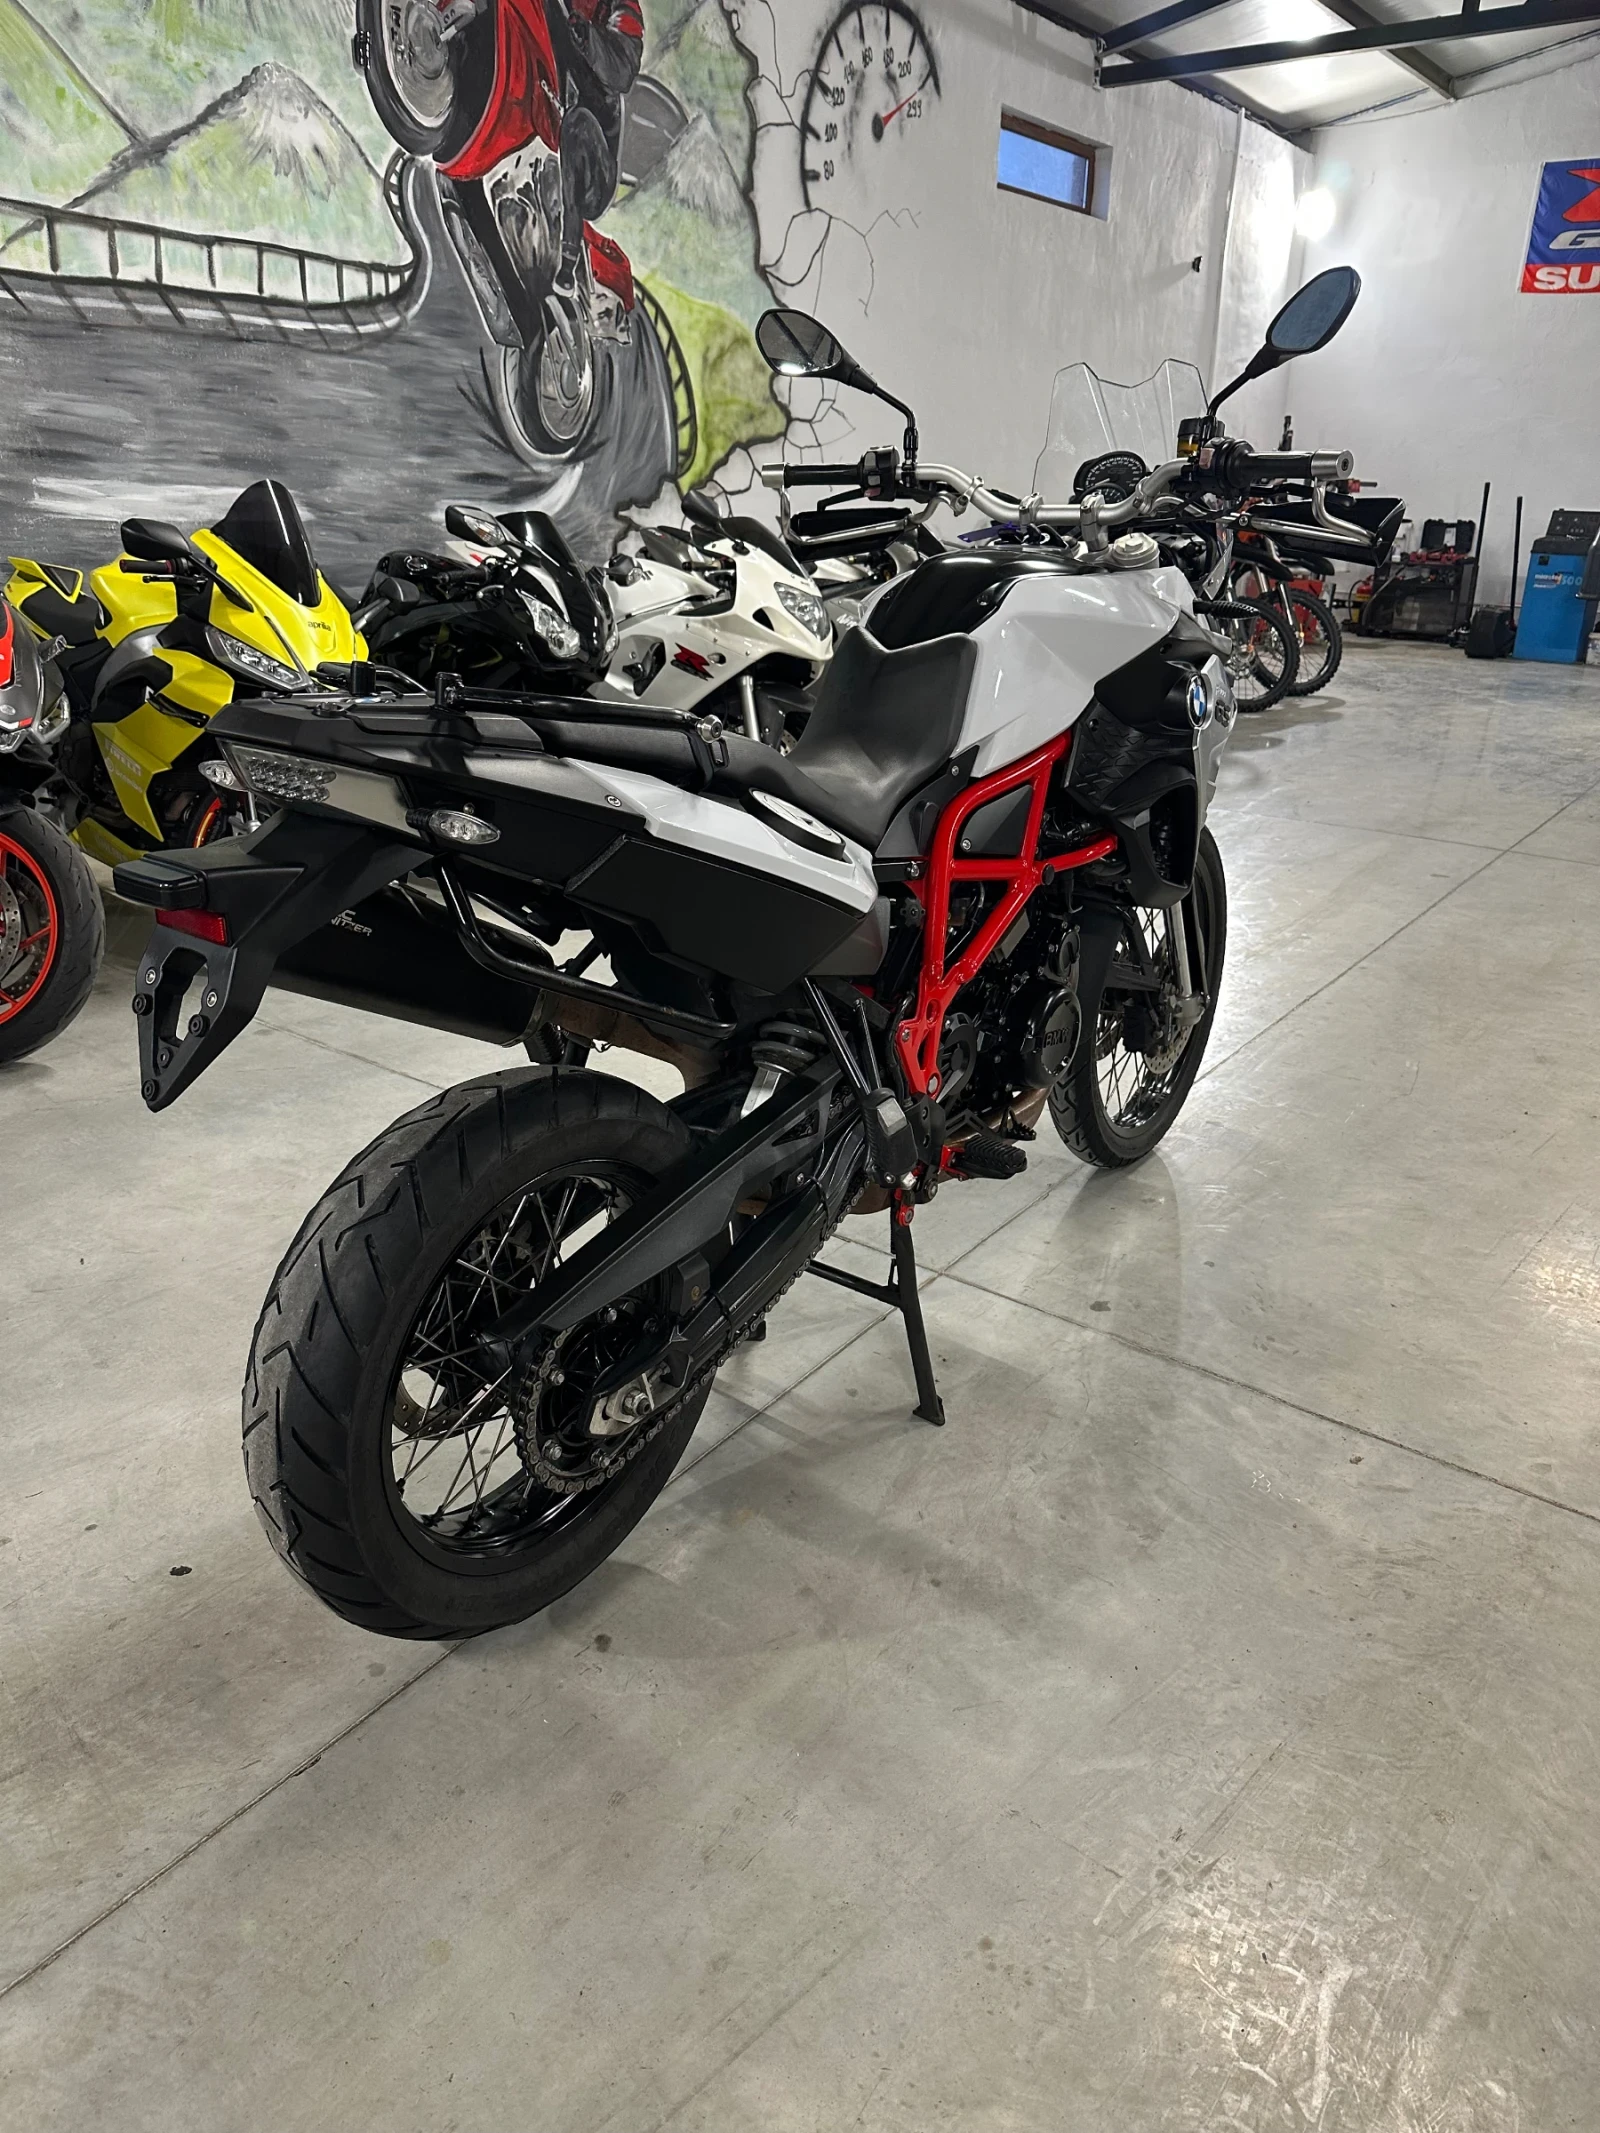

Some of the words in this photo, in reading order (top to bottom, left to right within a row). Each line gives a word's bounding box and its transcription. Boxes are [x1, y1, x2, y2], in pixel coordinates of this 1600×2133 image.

[861, 46, 873, 68] 160
[898, 60, 911, 78] 200
[832, 87, 846, 106] 120
[906, 99, 922, 118] 299
[824, 122, 838, 143] 100
[823, 159, 835, 180] 80
